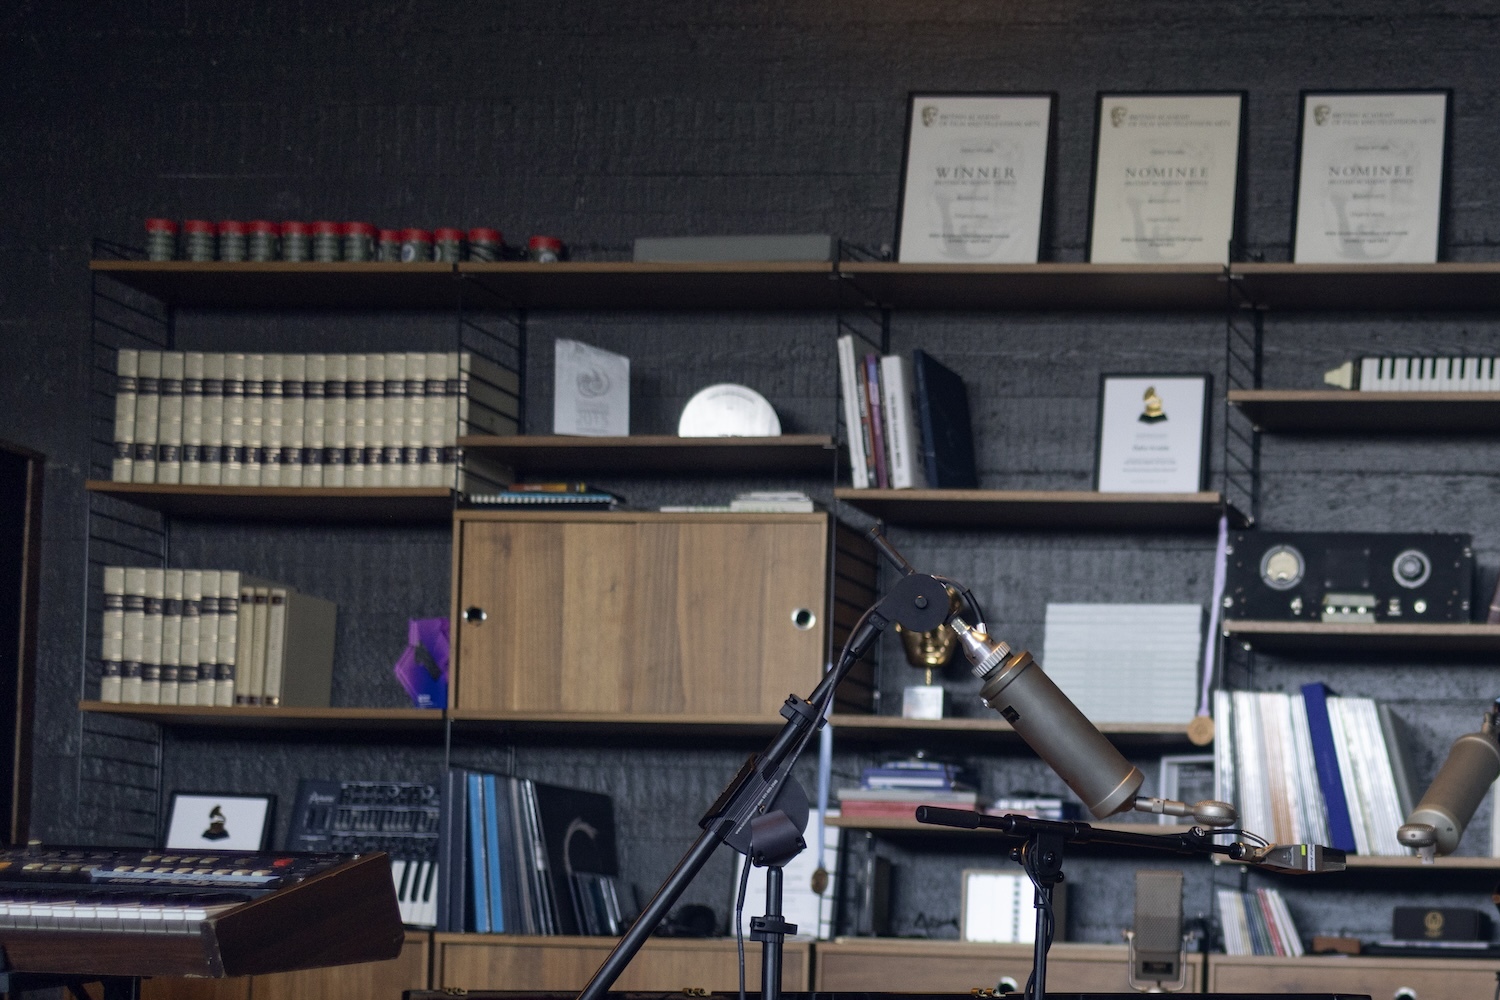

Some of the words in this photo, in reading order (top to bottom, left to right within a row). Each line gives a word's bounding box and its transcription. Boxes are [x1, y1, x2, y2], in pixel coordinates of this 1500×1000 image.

[936, 167, 1016, 178] WINNER
[1125, 167, 1209, 177] NOMINEE
[1329, 166, 1414, 176] NOMINEE
